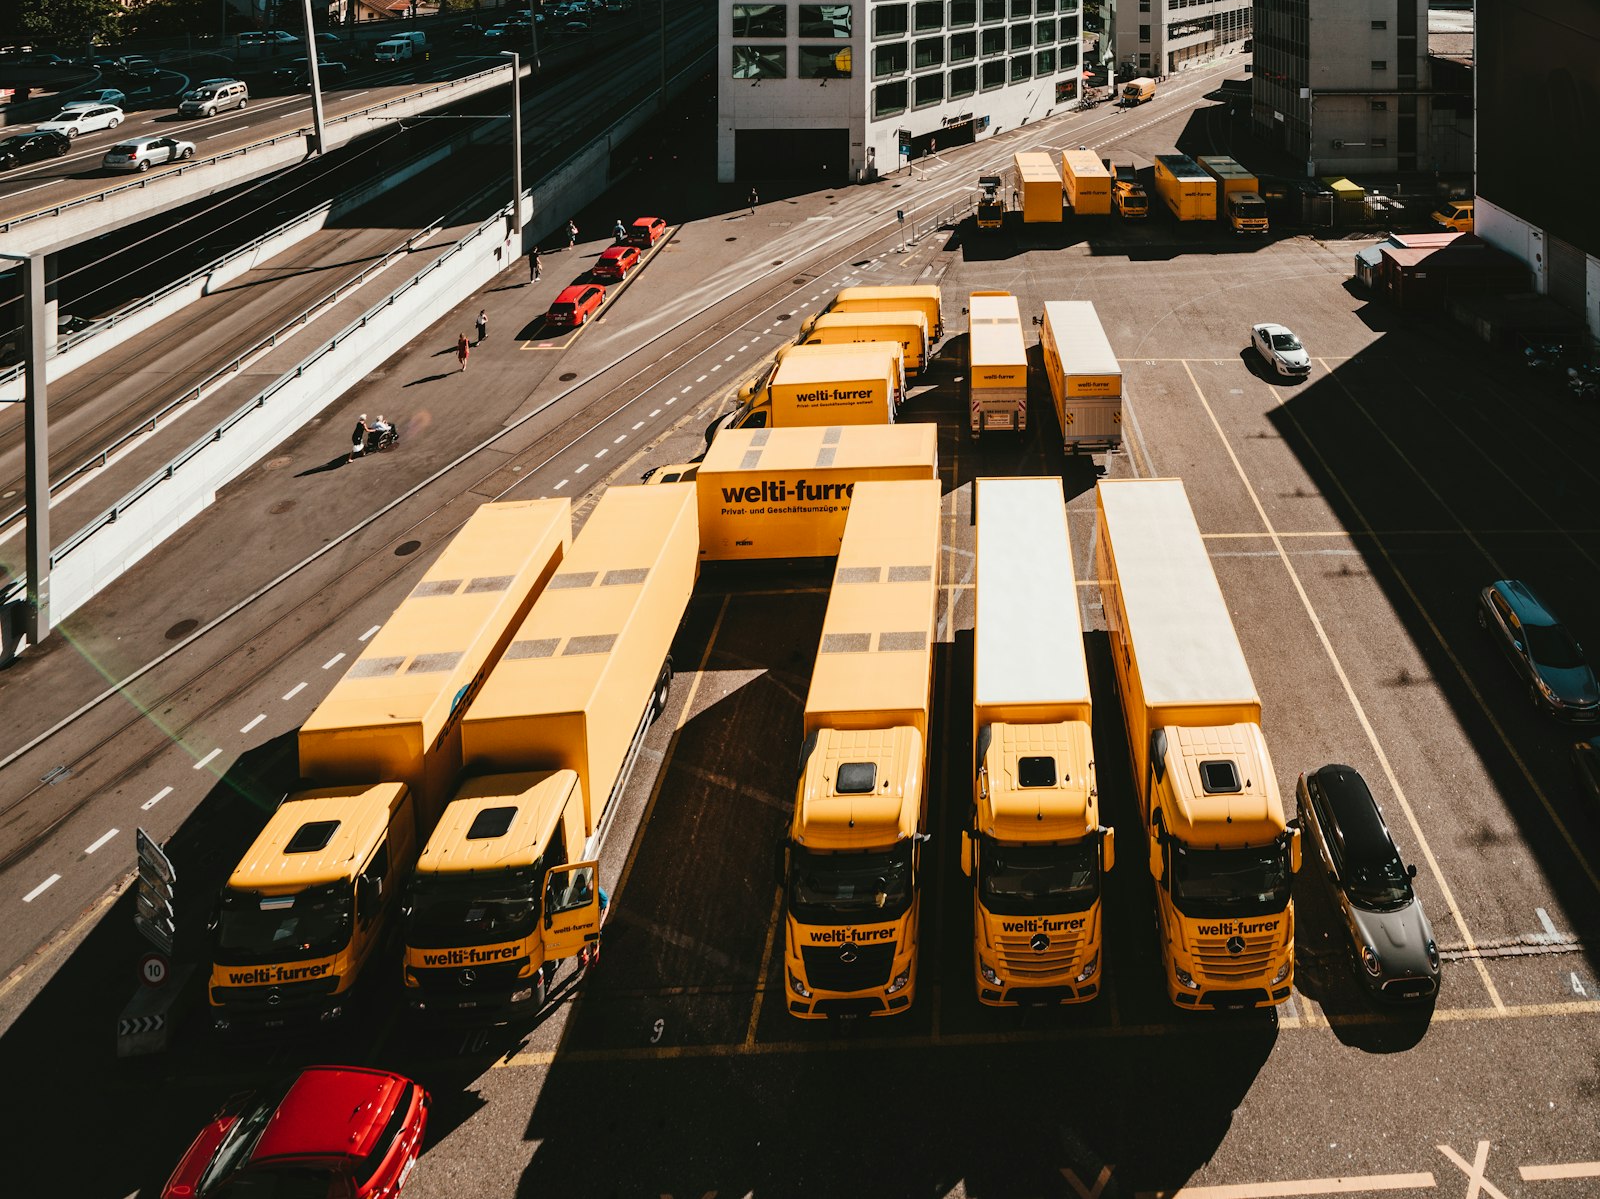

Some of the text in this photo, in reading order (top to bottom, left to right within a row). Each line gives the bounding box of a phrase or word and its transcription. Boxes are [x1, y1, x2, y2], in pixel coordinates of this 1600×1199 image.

[796, 389, 873, 402] welti-furrer
[721, 507, 747, 515] Privat-
[750, 507, 765, 515] und
[767, 505, 838, 514] Geschäftsumzüge
[553, 922, 594, 934] welti-furrer
[1002, 918, 1086, 932] welti-furrer
[1197, 920, 1280, 935] welti-furrer
[810, 927, 896, 943] welti-furrer
[424, 945, 520, 966] welti-furrer
[148, 965, 160, 977] 10
[229, 963, 331, 984] welti-furrer
[650, 1019, 665, 1044] 9
